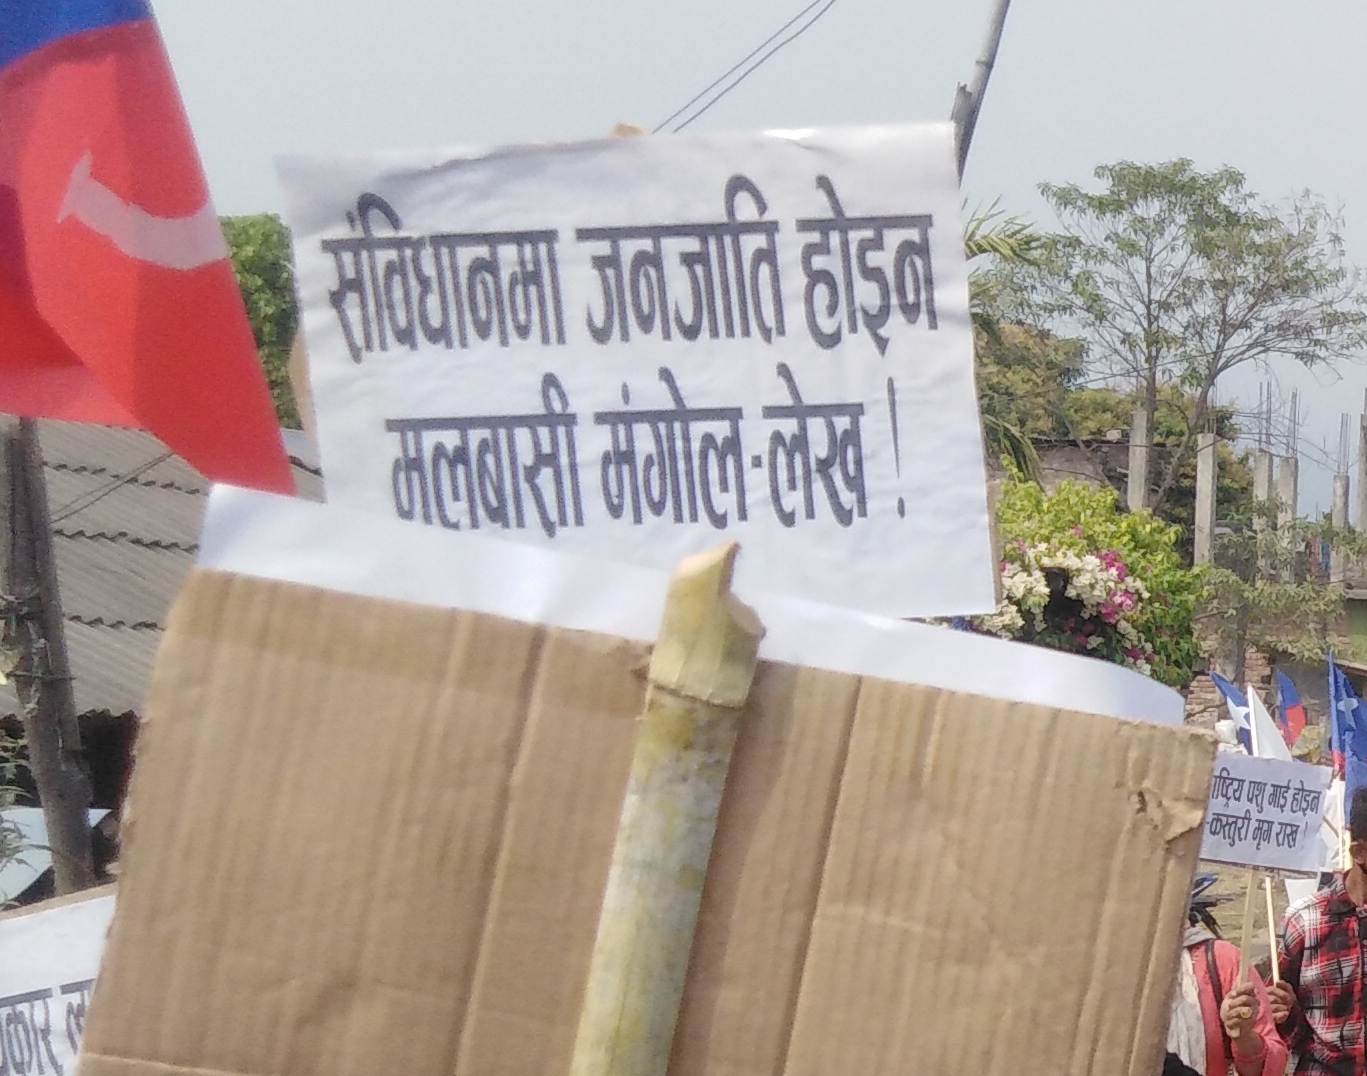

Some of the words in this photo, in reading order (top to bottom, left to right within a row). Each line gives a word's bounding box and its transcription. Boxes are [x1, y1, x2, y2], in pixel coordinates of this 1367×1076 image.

[321, 193, 566, 363] संविधानमा
[576, 175, 787, 345] जनजाति
[796, 175, 939, 355] होइन
[1247, 781, 1268, 814] पशु
[1290, 780, 1322, 817] होइन
[1252, 819, 1275, 850] मृग
[1275, 822, 1301, 849] राख
